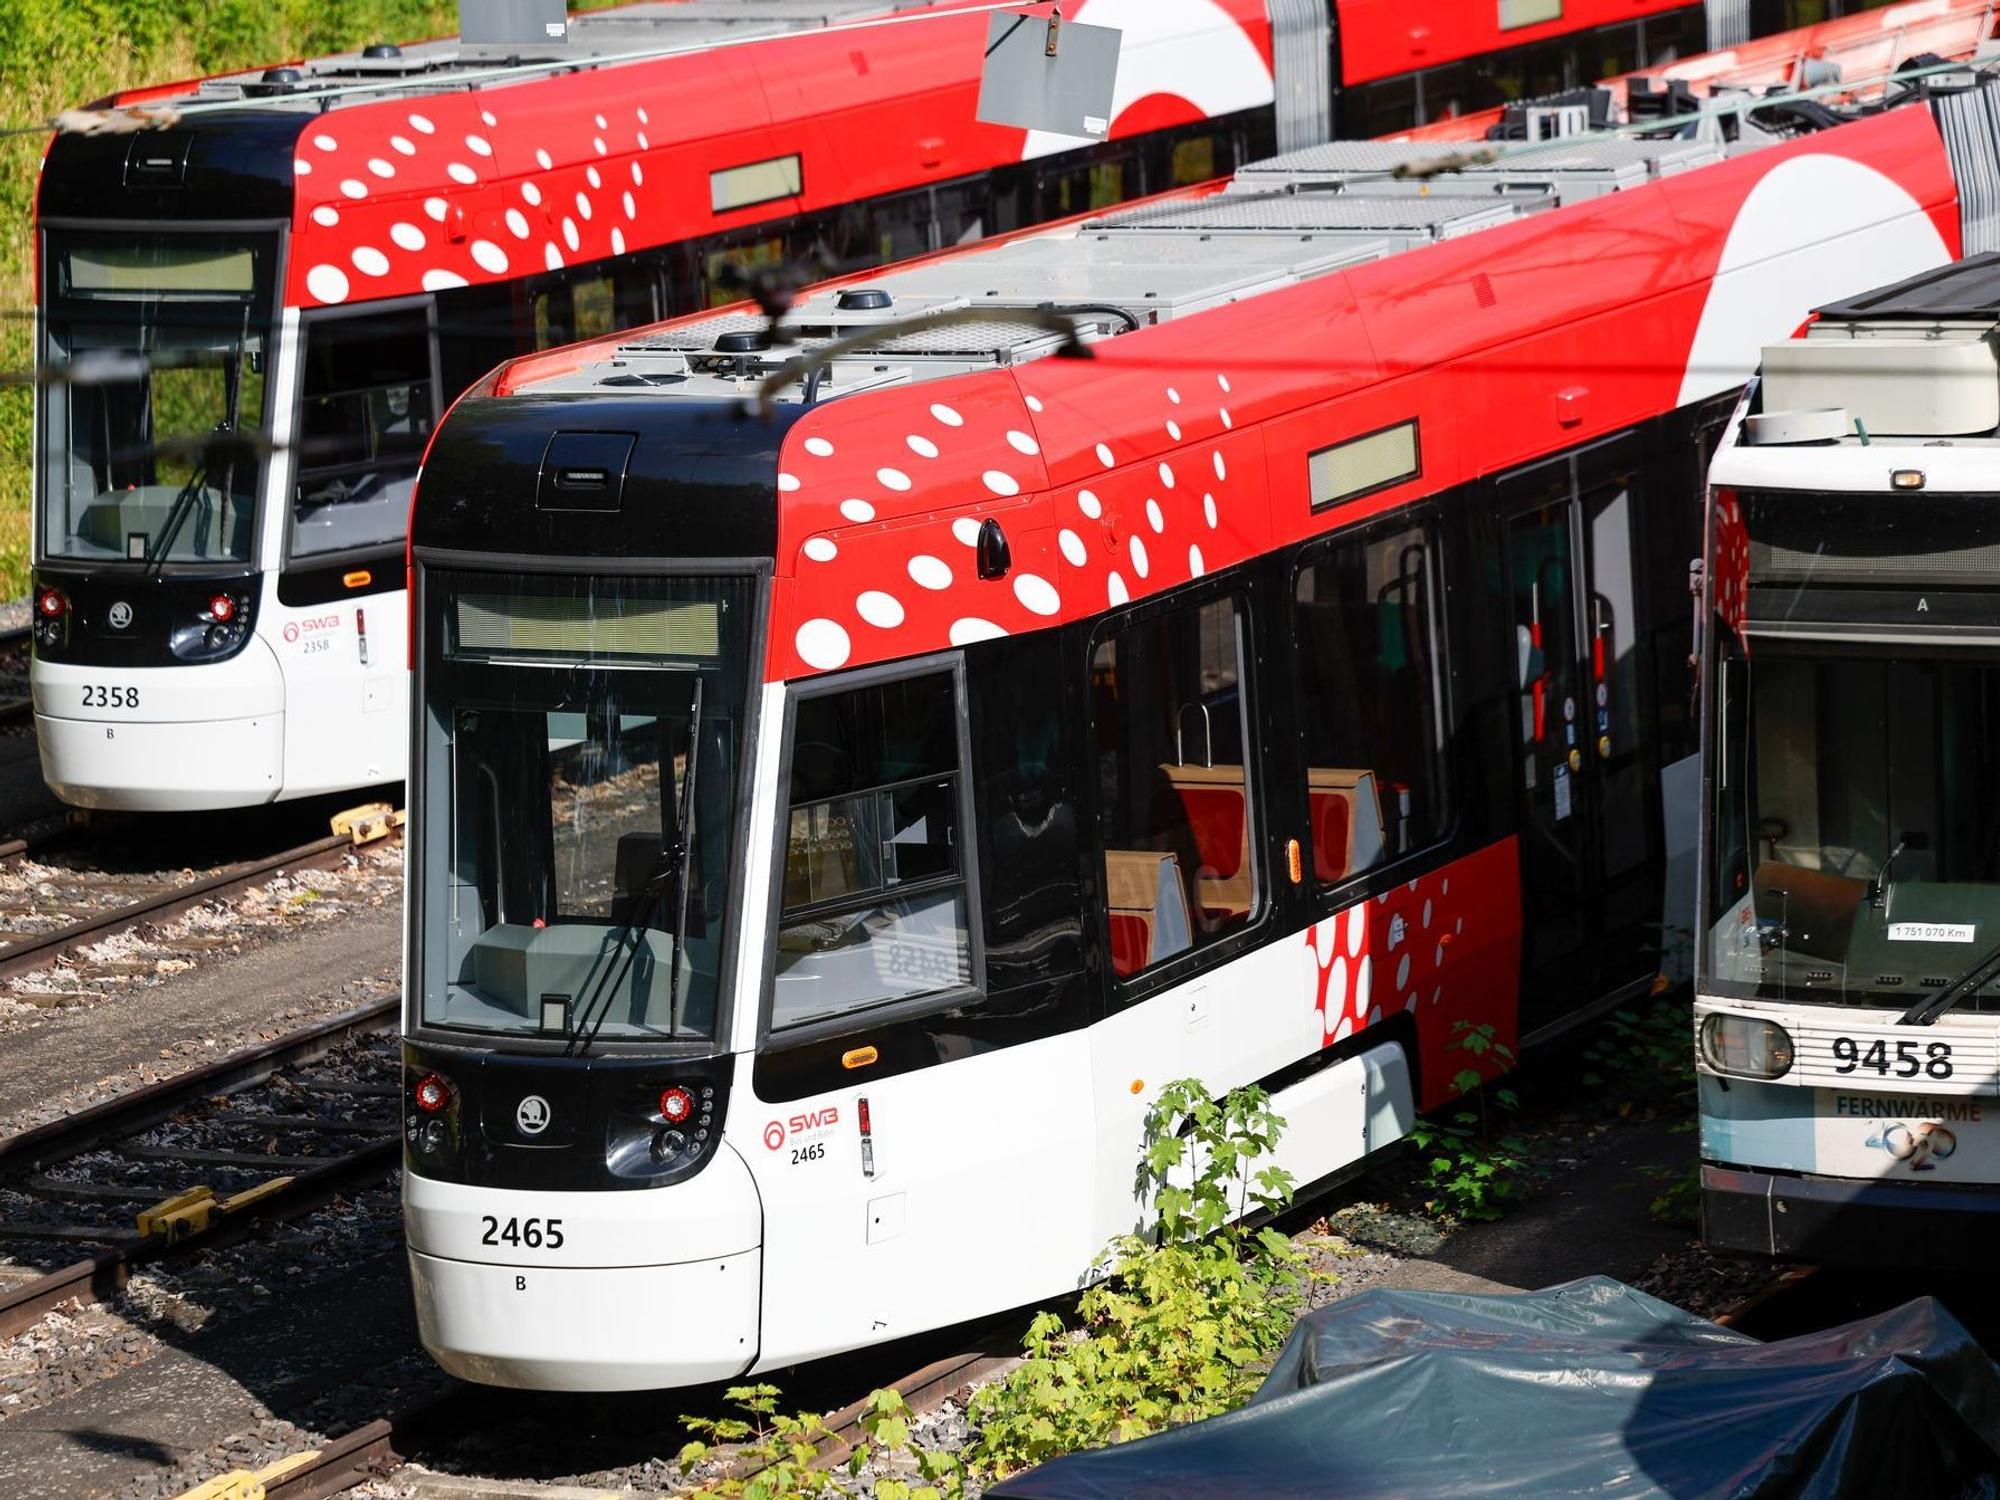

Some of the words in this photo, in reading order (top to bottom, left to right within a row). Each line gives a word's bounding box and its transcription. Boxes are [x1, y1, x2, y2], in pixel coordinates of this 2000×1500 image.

[1917, 598, 1928, 611] A
[302, 615, 341, 633] SWB
[304, 640, 330, 655] 2358
[82, 685, 139, 708] 2358
[106, 728, 114, 739] B
[1904, 927, 1922, 936] 751
[1926, 928, 1945, 937] 070
[1948, 929, 1966, 938] Km
[1832, 1037, 1953, 1079] 9458
[1836, 1096, 1981, 1121] FERNWÄRME
[789, 1107, 838, 1134] SWB
[792, 1142, 825, 1165] 2465
[482, 1216, 563, 1248] 2465
[516, 1276, 526, 1290] B
